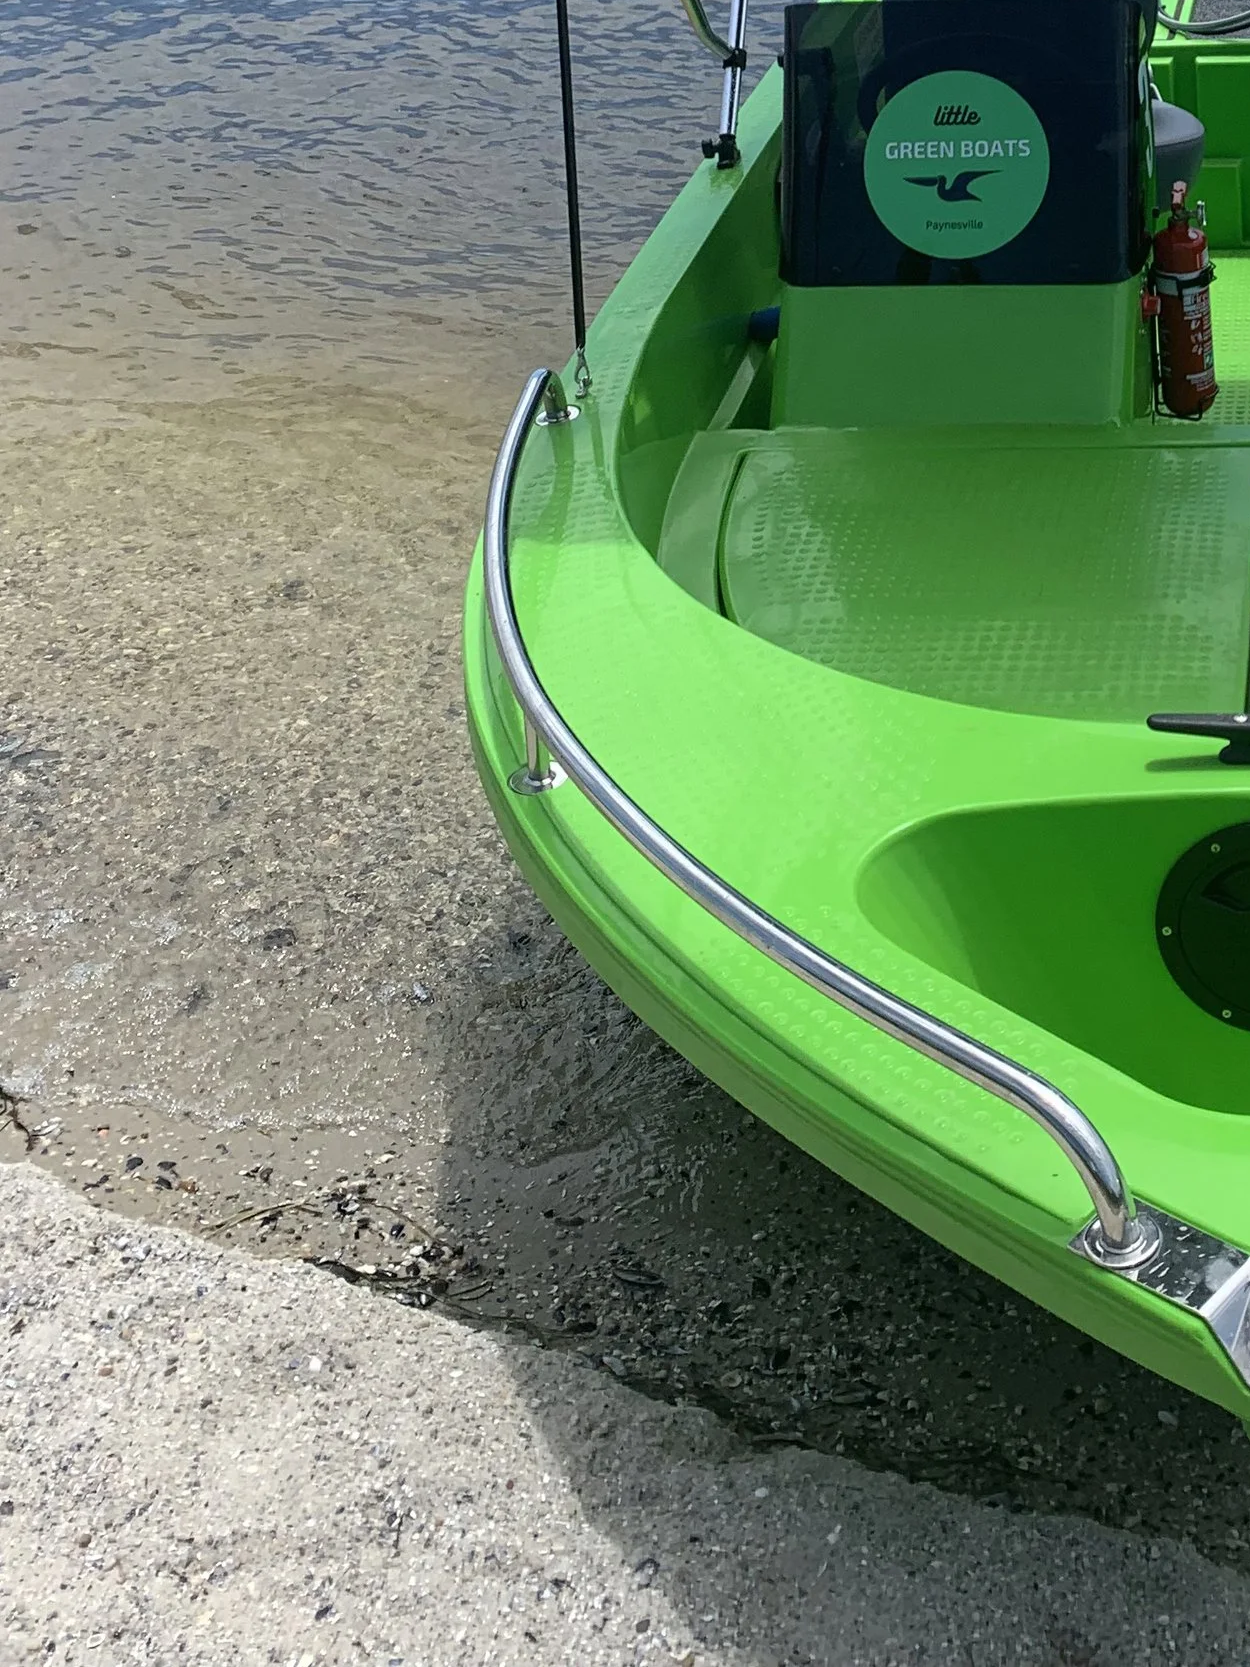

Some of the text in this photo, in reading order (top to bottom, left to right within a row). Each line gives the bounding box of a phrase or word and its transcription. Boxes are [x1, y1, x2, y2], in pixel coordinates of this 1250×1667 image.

[933, 105, 981, 126] little
[885, 139, 1031, 159] GREEN BOATS
[925, 220, 983, 232] Paynesville
